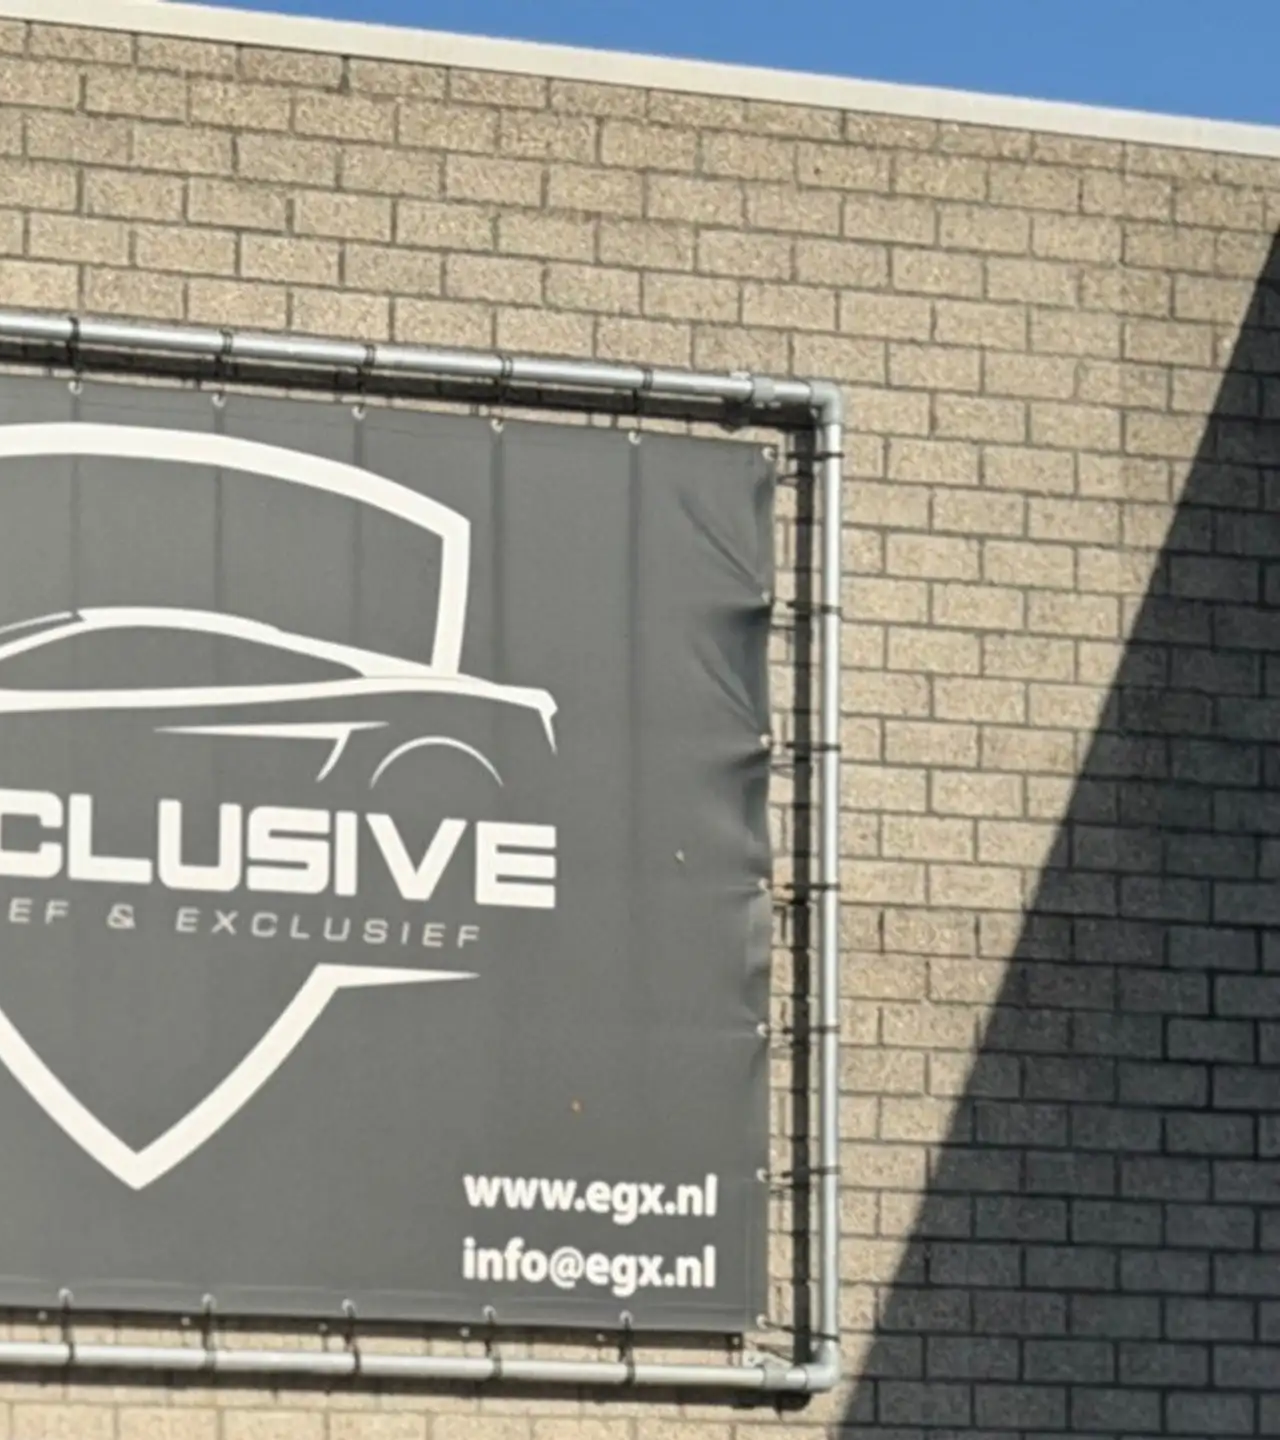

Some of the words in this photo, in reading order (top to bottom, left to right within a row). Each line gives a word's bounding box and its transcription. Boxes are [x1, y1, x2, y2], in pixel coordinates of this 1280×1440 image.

[107, 904, 136, 930] &
[176, 908, 481, 948] EXCLUSIEF
[463, 1173, 718, 1225] www.egx.nl
[462, 1236, 716, 1297] info@egx.nl
